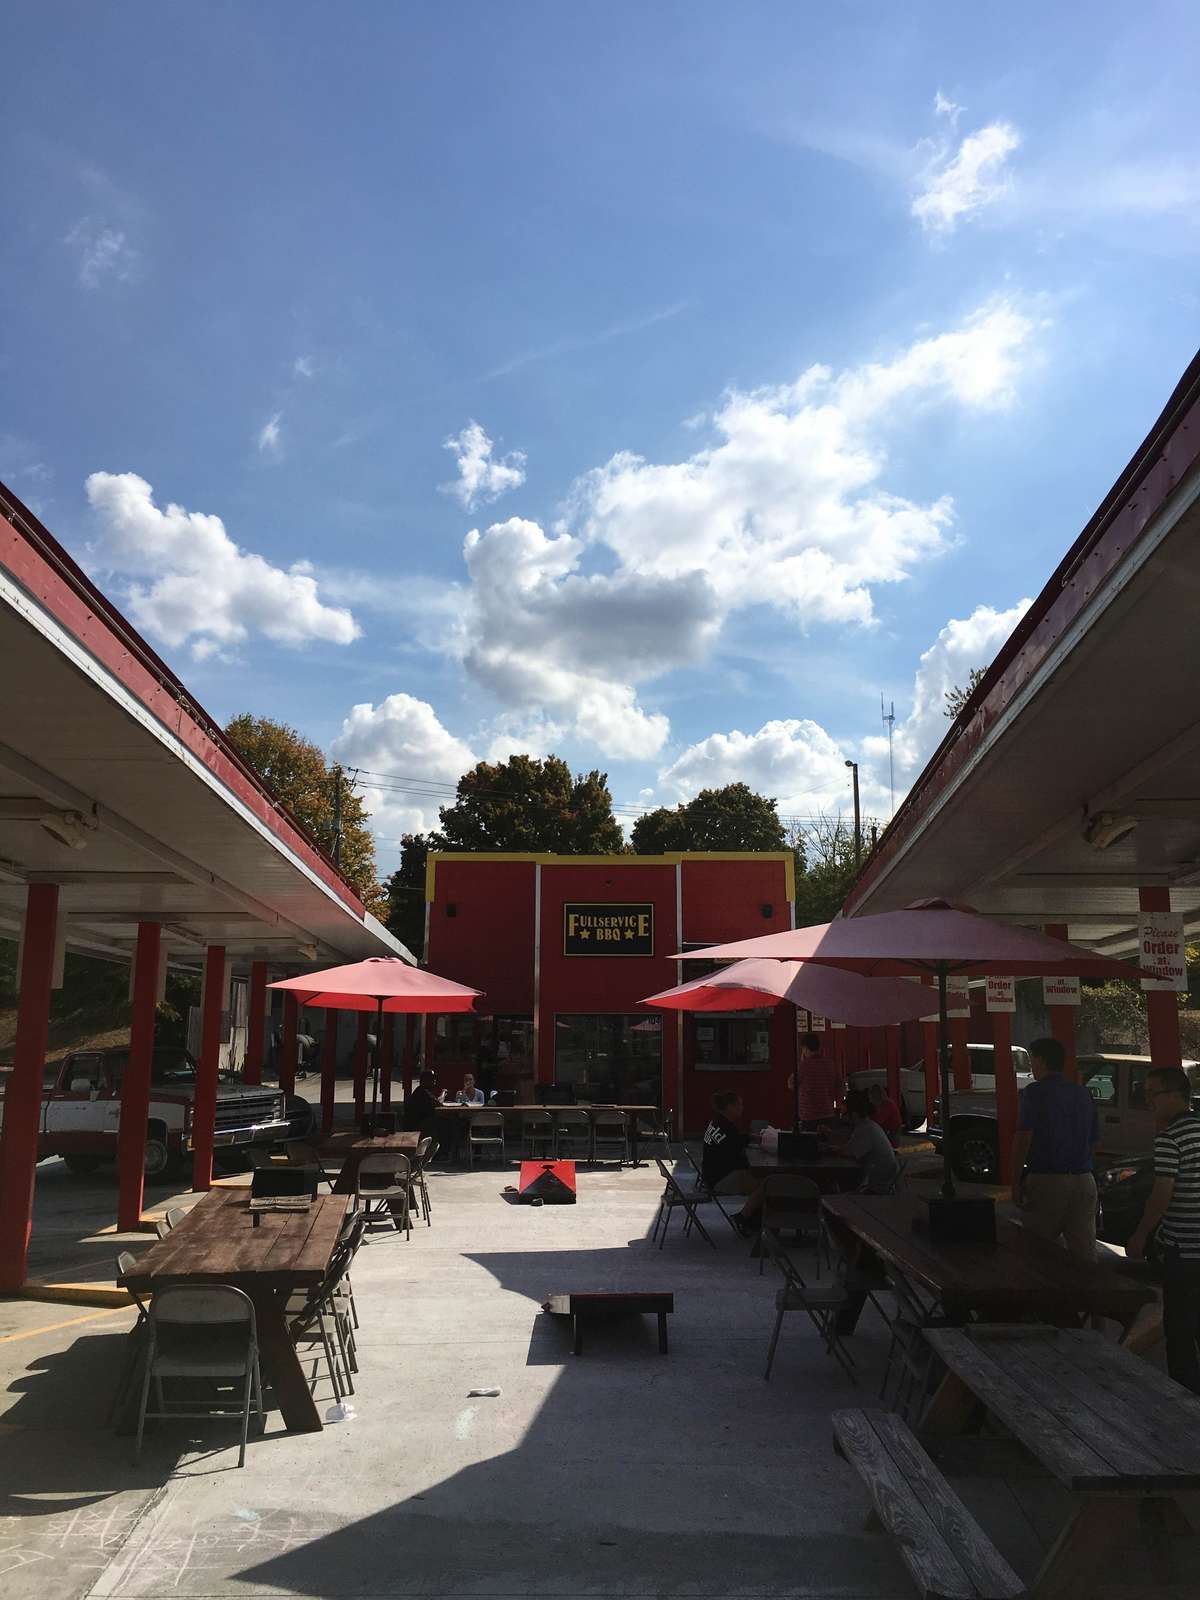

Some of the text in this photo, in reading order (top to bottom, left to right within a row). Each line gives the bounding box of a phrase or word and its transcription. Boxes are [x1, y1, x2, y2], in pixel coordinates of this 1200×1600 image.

[568, 914, 649, 937] FULLSERVICE
[1143, 926, 1178, 938] Please
[596, 928, 621, 941] BBQ
[1143, 941, 1180, 955] Order
[988, 980, 1012, 990] Order
